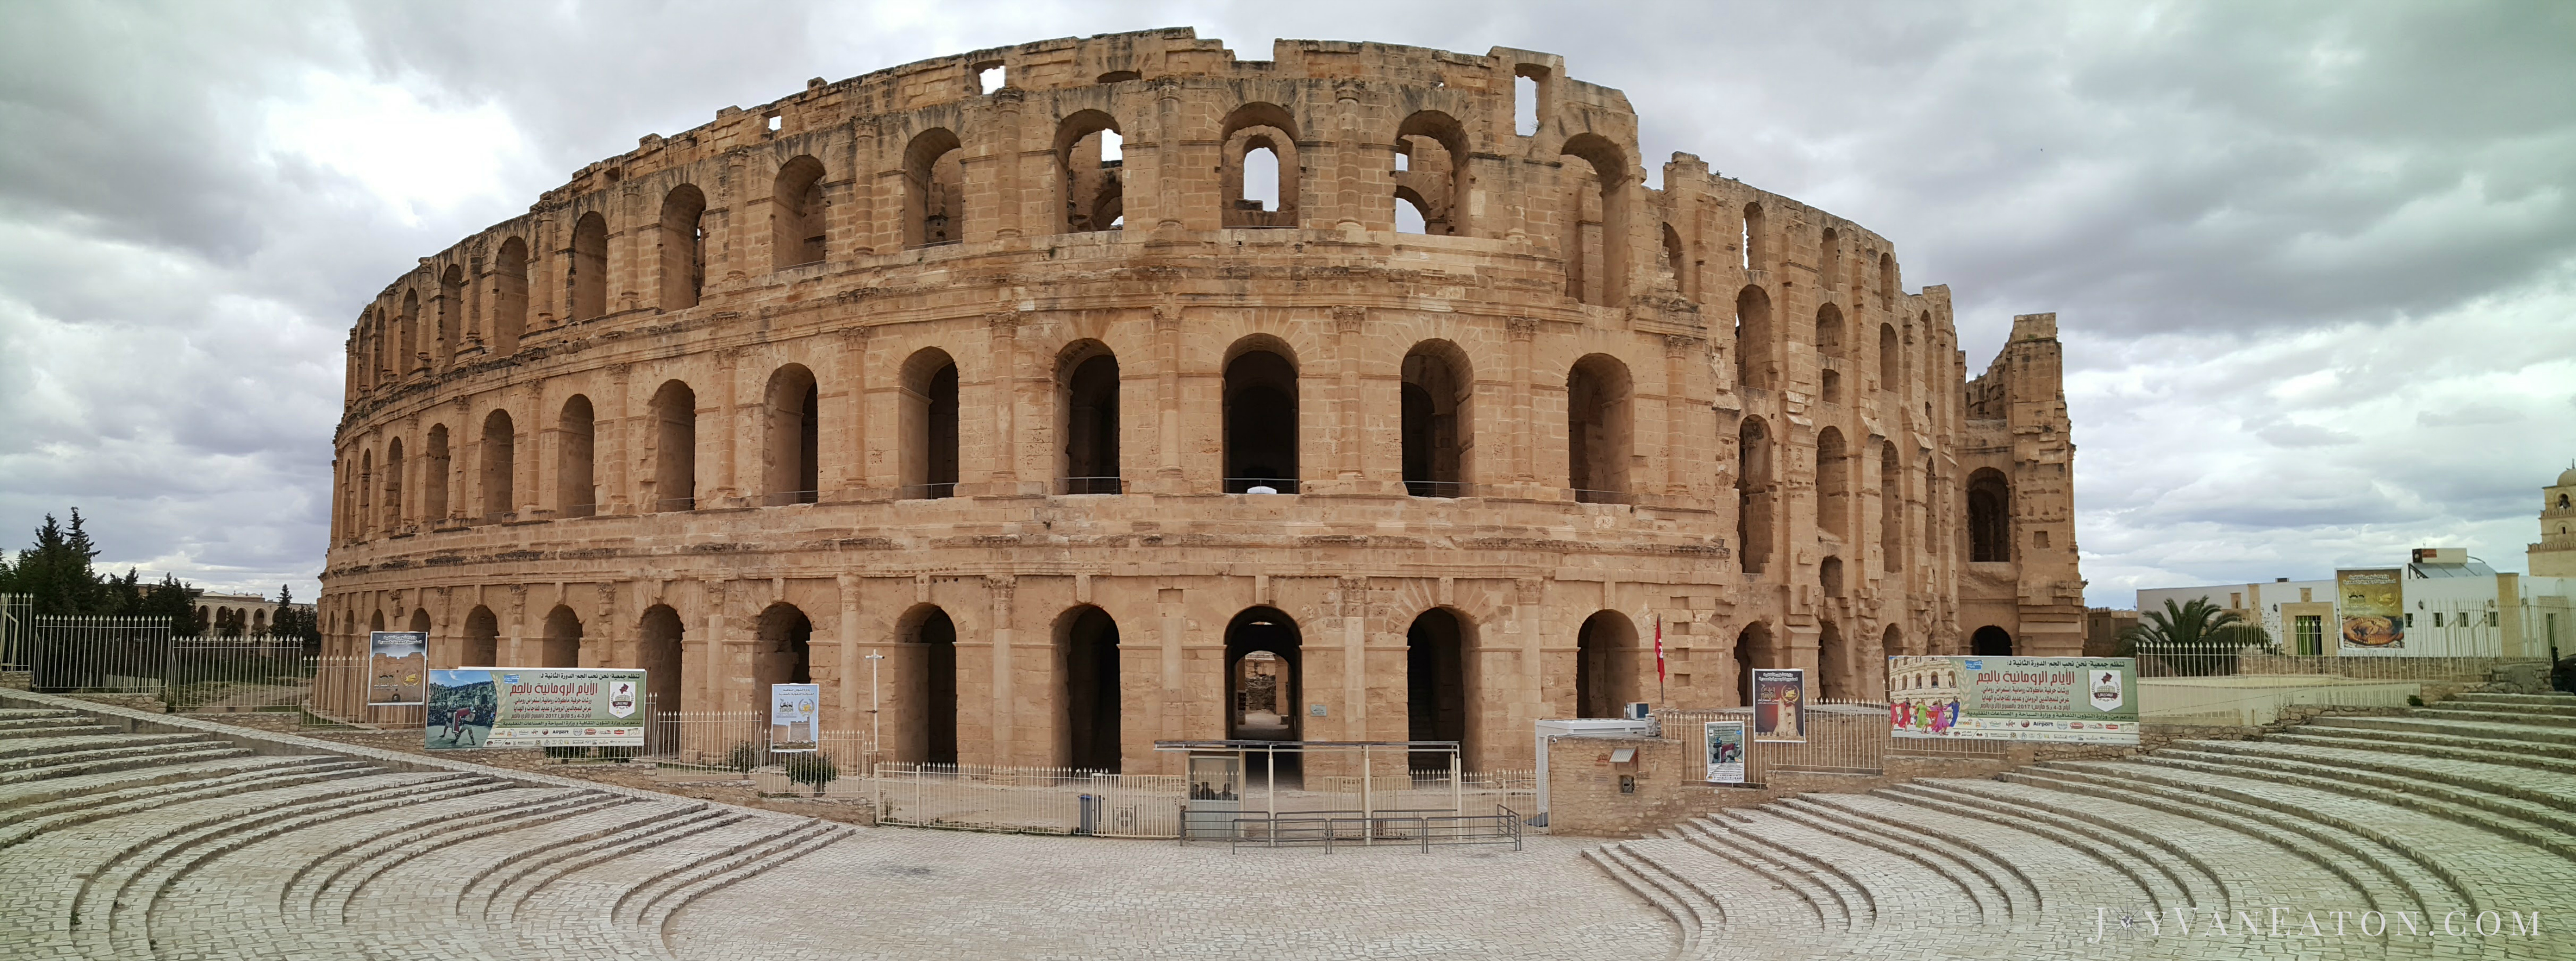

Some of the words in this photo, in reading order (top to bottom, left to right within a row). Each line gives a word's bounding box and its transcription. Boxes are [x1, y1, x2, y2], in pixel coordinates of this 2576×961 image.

[1976, 670, 2000, 685] بالجم
[2003, 670, 2048, 685] الرومانية
[2050, 668, 2075, 686] الأيام
[510, 682, 532, 696] بالجم
[535, 682, 574, 696] الرومانية
[577, 681, 598, 696] الأيام
